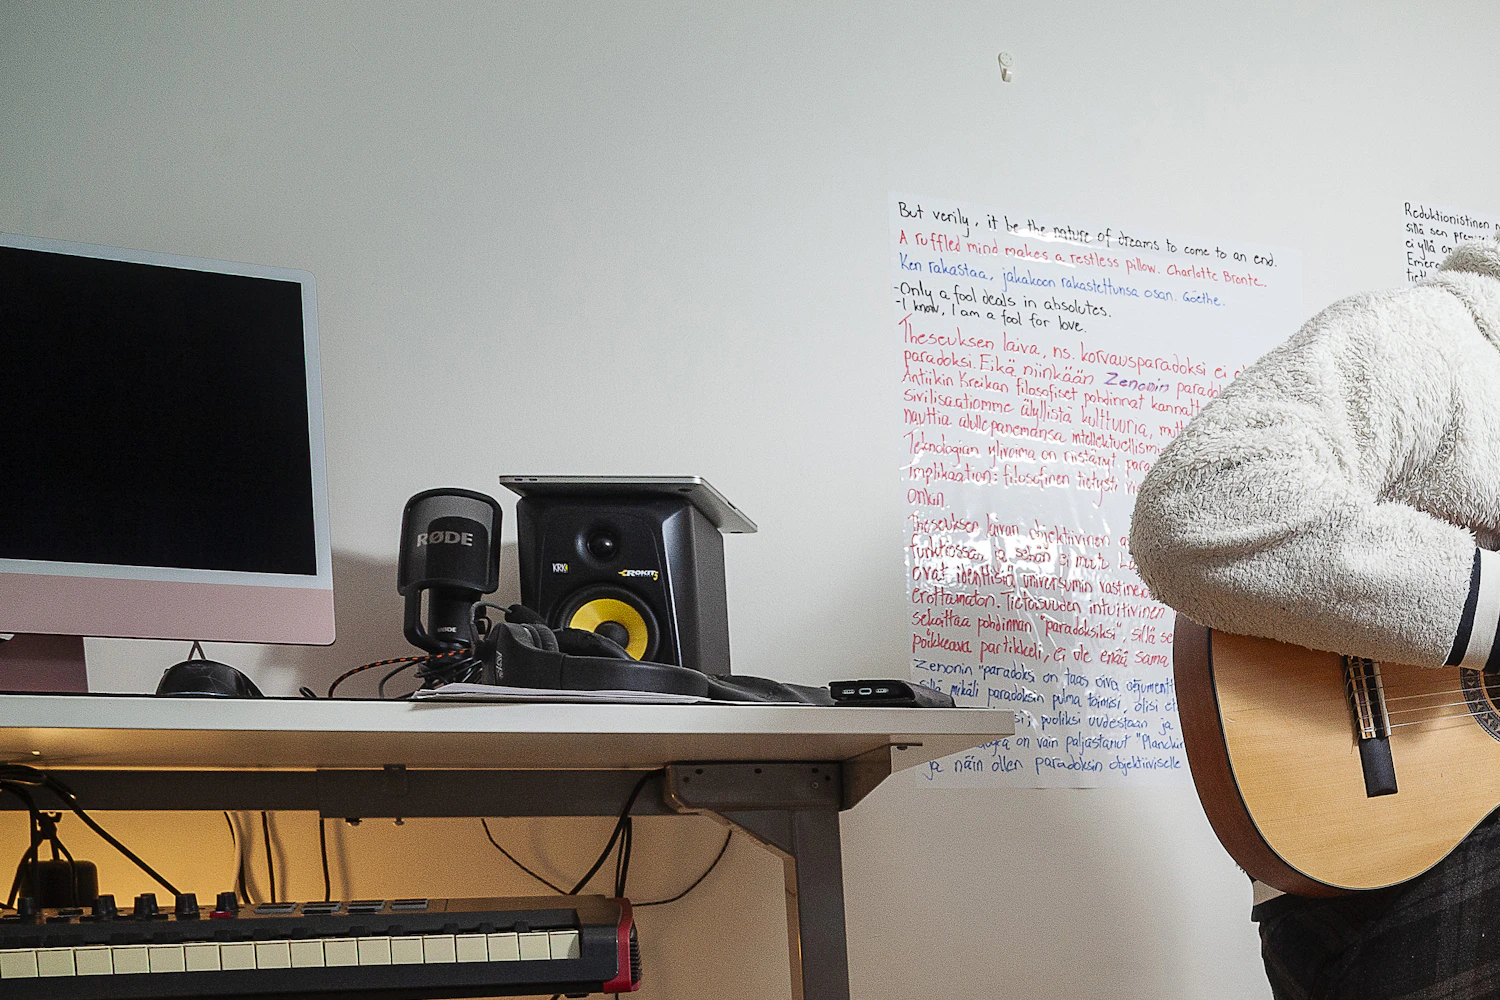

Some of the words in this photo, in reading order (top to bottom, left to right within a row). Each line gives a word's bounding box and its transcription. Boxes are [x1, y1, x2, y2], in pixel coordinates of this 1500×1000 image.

[1404, 202, 1490, 230] Reduktionistinen
[899, 202, 923, 219] But
[988, 214, 998, 230] it
[1005, 216, 1019, 232] be
[1027, 219, 1046, 233] the
[1053, 225, 1092, 244] nature
[1098, 228, 1111, 248] of
[1118, 231, 1160, 251] dreams
[1166, 239, 1178, 253] to
[1184, 246, 1210, 257] come
[1215, 247, 1227, 259] to
[1234, 252, 1247, 263] an
[1254, 253, 1277, 267] end.
[1406, 222, 1425, 236] sillä
[1430, 228, 1448, 239] sen
[899, 230, 908, 245] A
[915, 233, 961, 253] ruffled
[967, 239, 998, 255] mind
[1005, 244, 1048, 260] makes
[1055, 253, 1068, 263] a
[1071, 252, 1120, 269] restless
[1126, 257, 1161, 275] pillow.
[1167, 264, 1219, 282] Charlotte
[1405, 239, 1415, 249] ei
[899, 252, 923, 271] Ken
[929, 258, 994, 281] rakastaa,
[1001, 267, 1055, 293] jakakoon
[1061, 276, 1139, 298] rakastettunsa
[1144, 289, 1177, 302] osan.
[940, 290, 951, 301] a
[954, 285, 977, 305] fool
[983, 289, 1017, 308] deals
[1024, 295, 1037, 308] in
[1044, 297, 1111, 318] absolutes.
[961, 309, 980, 319] am
[987, 311, 997, 321] a
[1001, 308, 1022, 327] fool
[1030, 313, 1050, 328] for
[1058, 316, 1087, 333] love.
[898, 312, 995, 351] Theseuksen
[1003, 331, 1046, 359] laiva,
[1053, 346, 1076, 361] ns.
[1080, 341, 1207, 376] korvausparadoksi
[1214, 365, 1227, 380] ei
[903, 349, 976, 371] paradoksi.
[980, 353, 1017, 378] Eikä
[1023, 361, 1094, 385] niinkään
[901, 369, 954, 387] Antiikin
[959, 371, 1008, 393] Kreikan
[1016, 377, 1079, 403] filosofiset
[1083, 387, 1146, 410] pohdinnat
[903, 406, 952, 426] nauttia
[1021, 398, 1073, 429] älyllistä
[903, 427, 980, 467] Teknologian
[988, 439, 1036, 469] ylivoima
[1041, 449, 1057, 462] on
[1003, 463, 1070, 488] filosofinen
[908, 512, 980, 535] Theseuksen
[417, 531, 473, 547] RØDE
[912, 562, 948, 582] ovat
[1023, 574, 1094, 592] universumin
[1130, 623, 1156, 644] sillä
[1073, 642, 1093, 664] ole
[1100, 648, 1129, 667] enää
[1134, 650, 1170, 668] sama
[914, 658, 973, 676] Zenonin
[1043, 672, 1059, 684] on
[1065, 667, 1089, 687] taas
[1053, 688, 1084, 711] pulma
[1041, 711, 1082, 731] puoliksi
[1089, 713, 1148, 733] uudestaan
[1159, 717, 1174, 736] ja
[1016, 736, 1030, 749] on
[1036, 735, 1059, 749] vain
[1066, 731, 1131, 756] paljastanut
[954, 755, 983, 773] näin
[992, 754, 1024, 773] ollen
[1035, 754, 1103, 776] paradoksin
[1109, 755, 1183, 777] objektiiviselle
